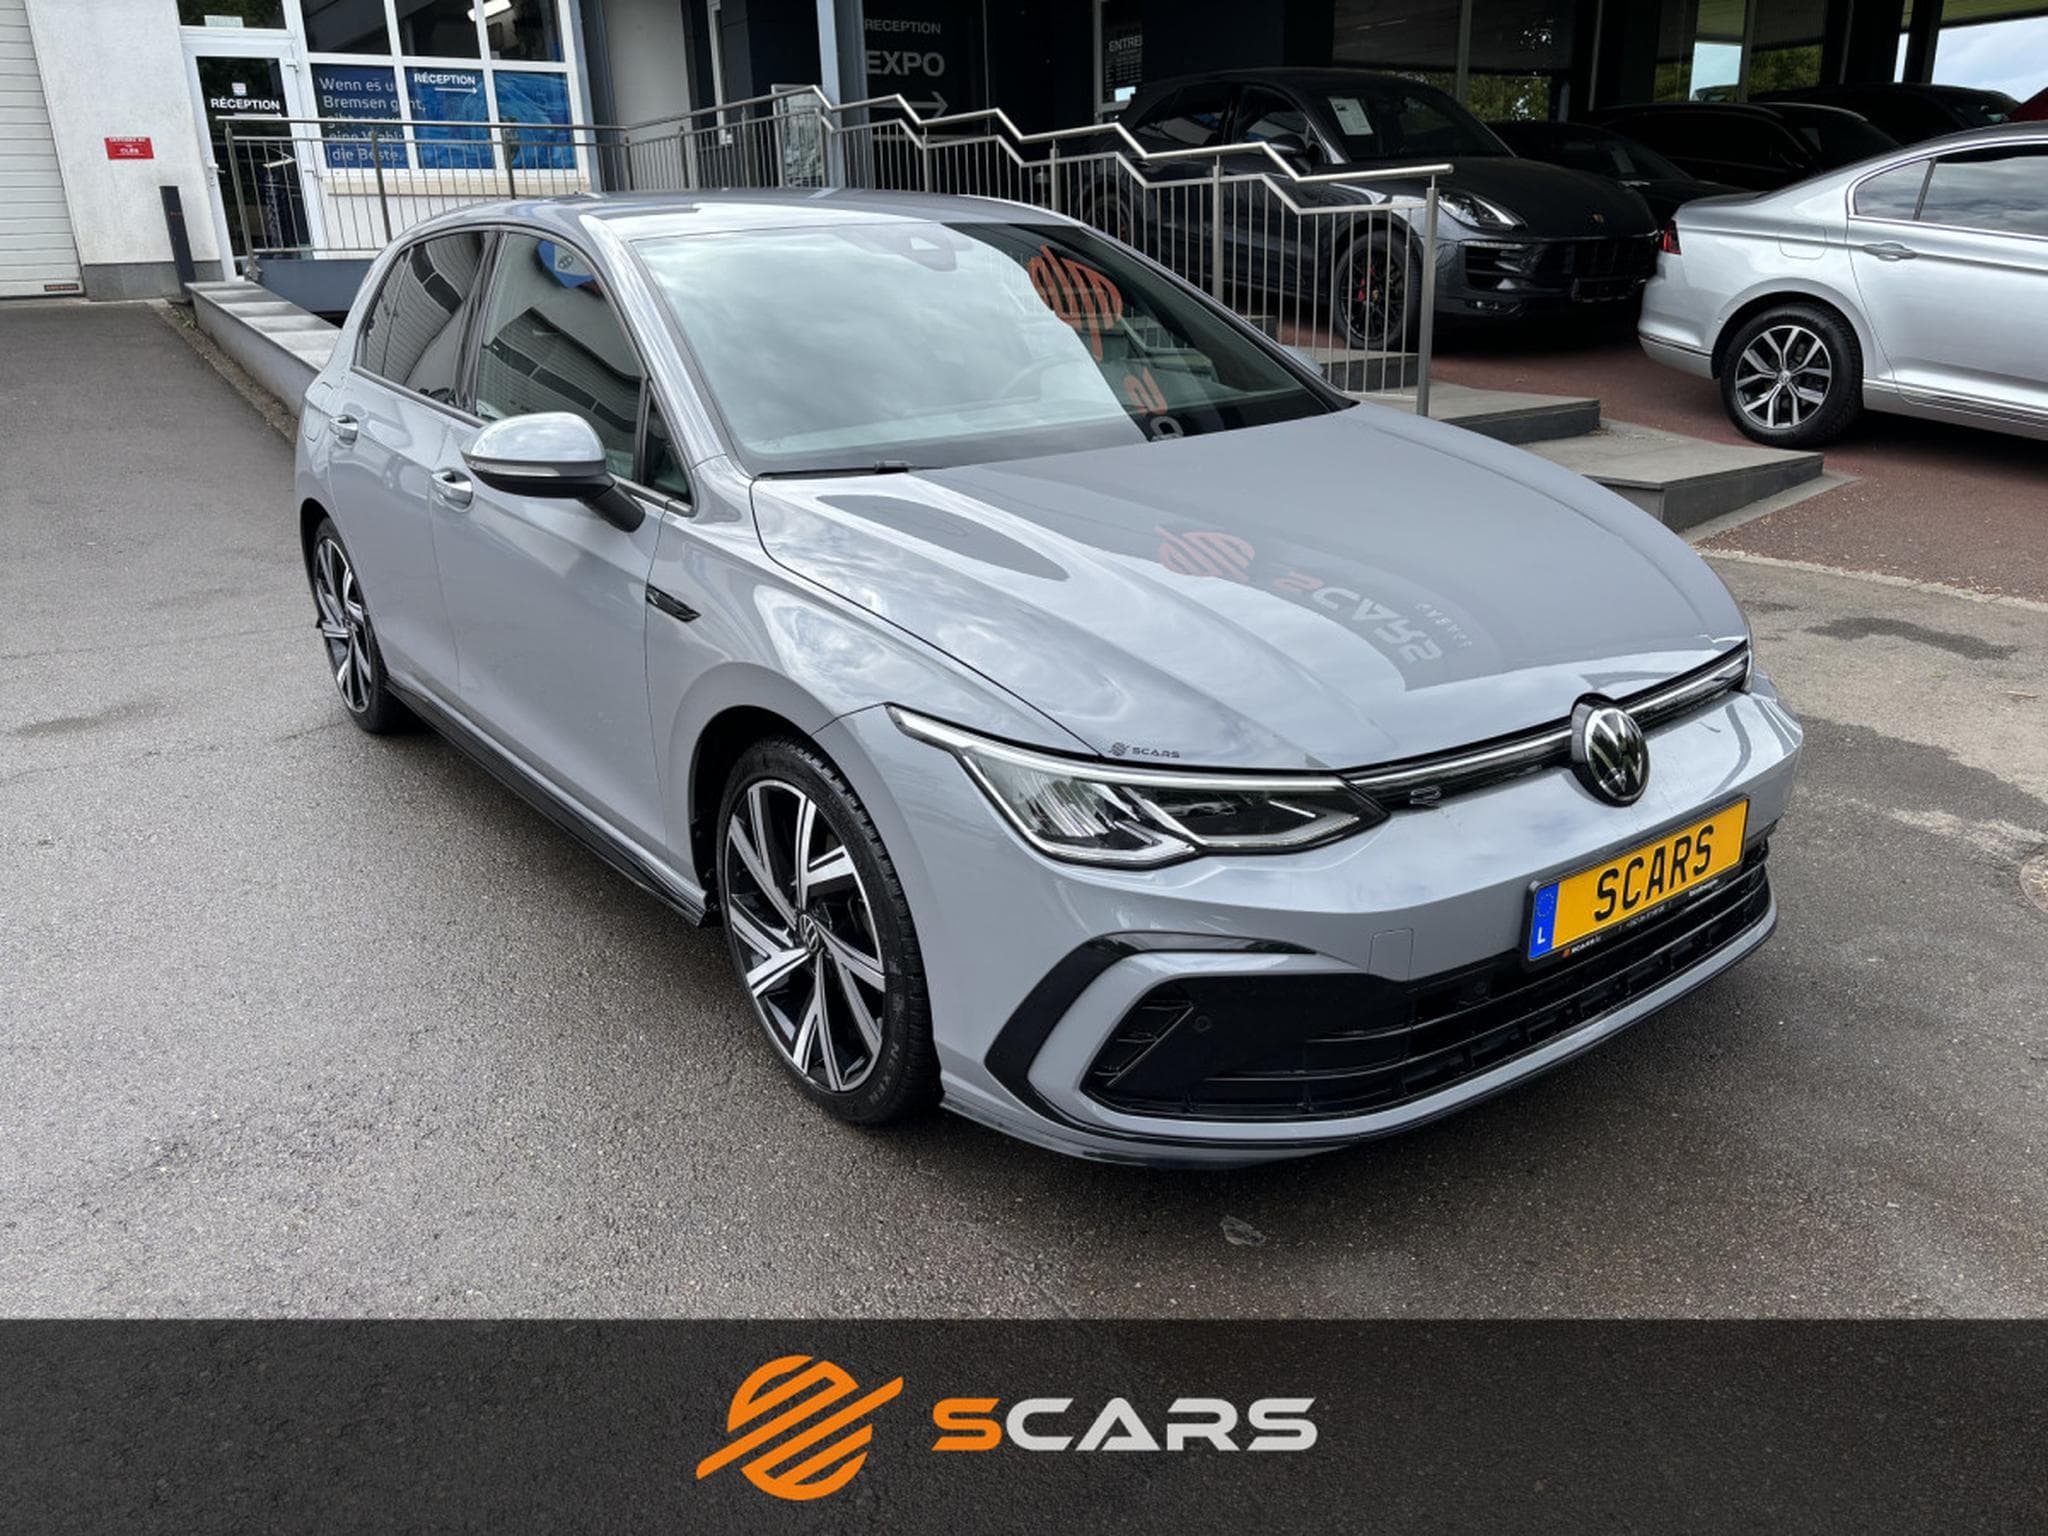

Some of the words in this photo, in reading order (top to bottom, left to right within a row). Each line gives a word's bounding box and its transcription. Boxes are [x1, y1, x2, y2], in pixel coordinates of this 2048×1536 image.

[865, 49, 945, 77] EXPO
[319, 77, 362, 91] Wenn
[366, 80, 382, 92] es
[414, 72, 476, 85] RÉCEPTION
[210, 95, 281, 110] RÉCEPTION
[323, 95, 387, 109] Bremsen
[332, 147, 354, 161] die
[1132, 746, 1180, 759] SCARS
[1594, 824, 1714, 922] SCARS
[1536, 926, 1546, 945] L
